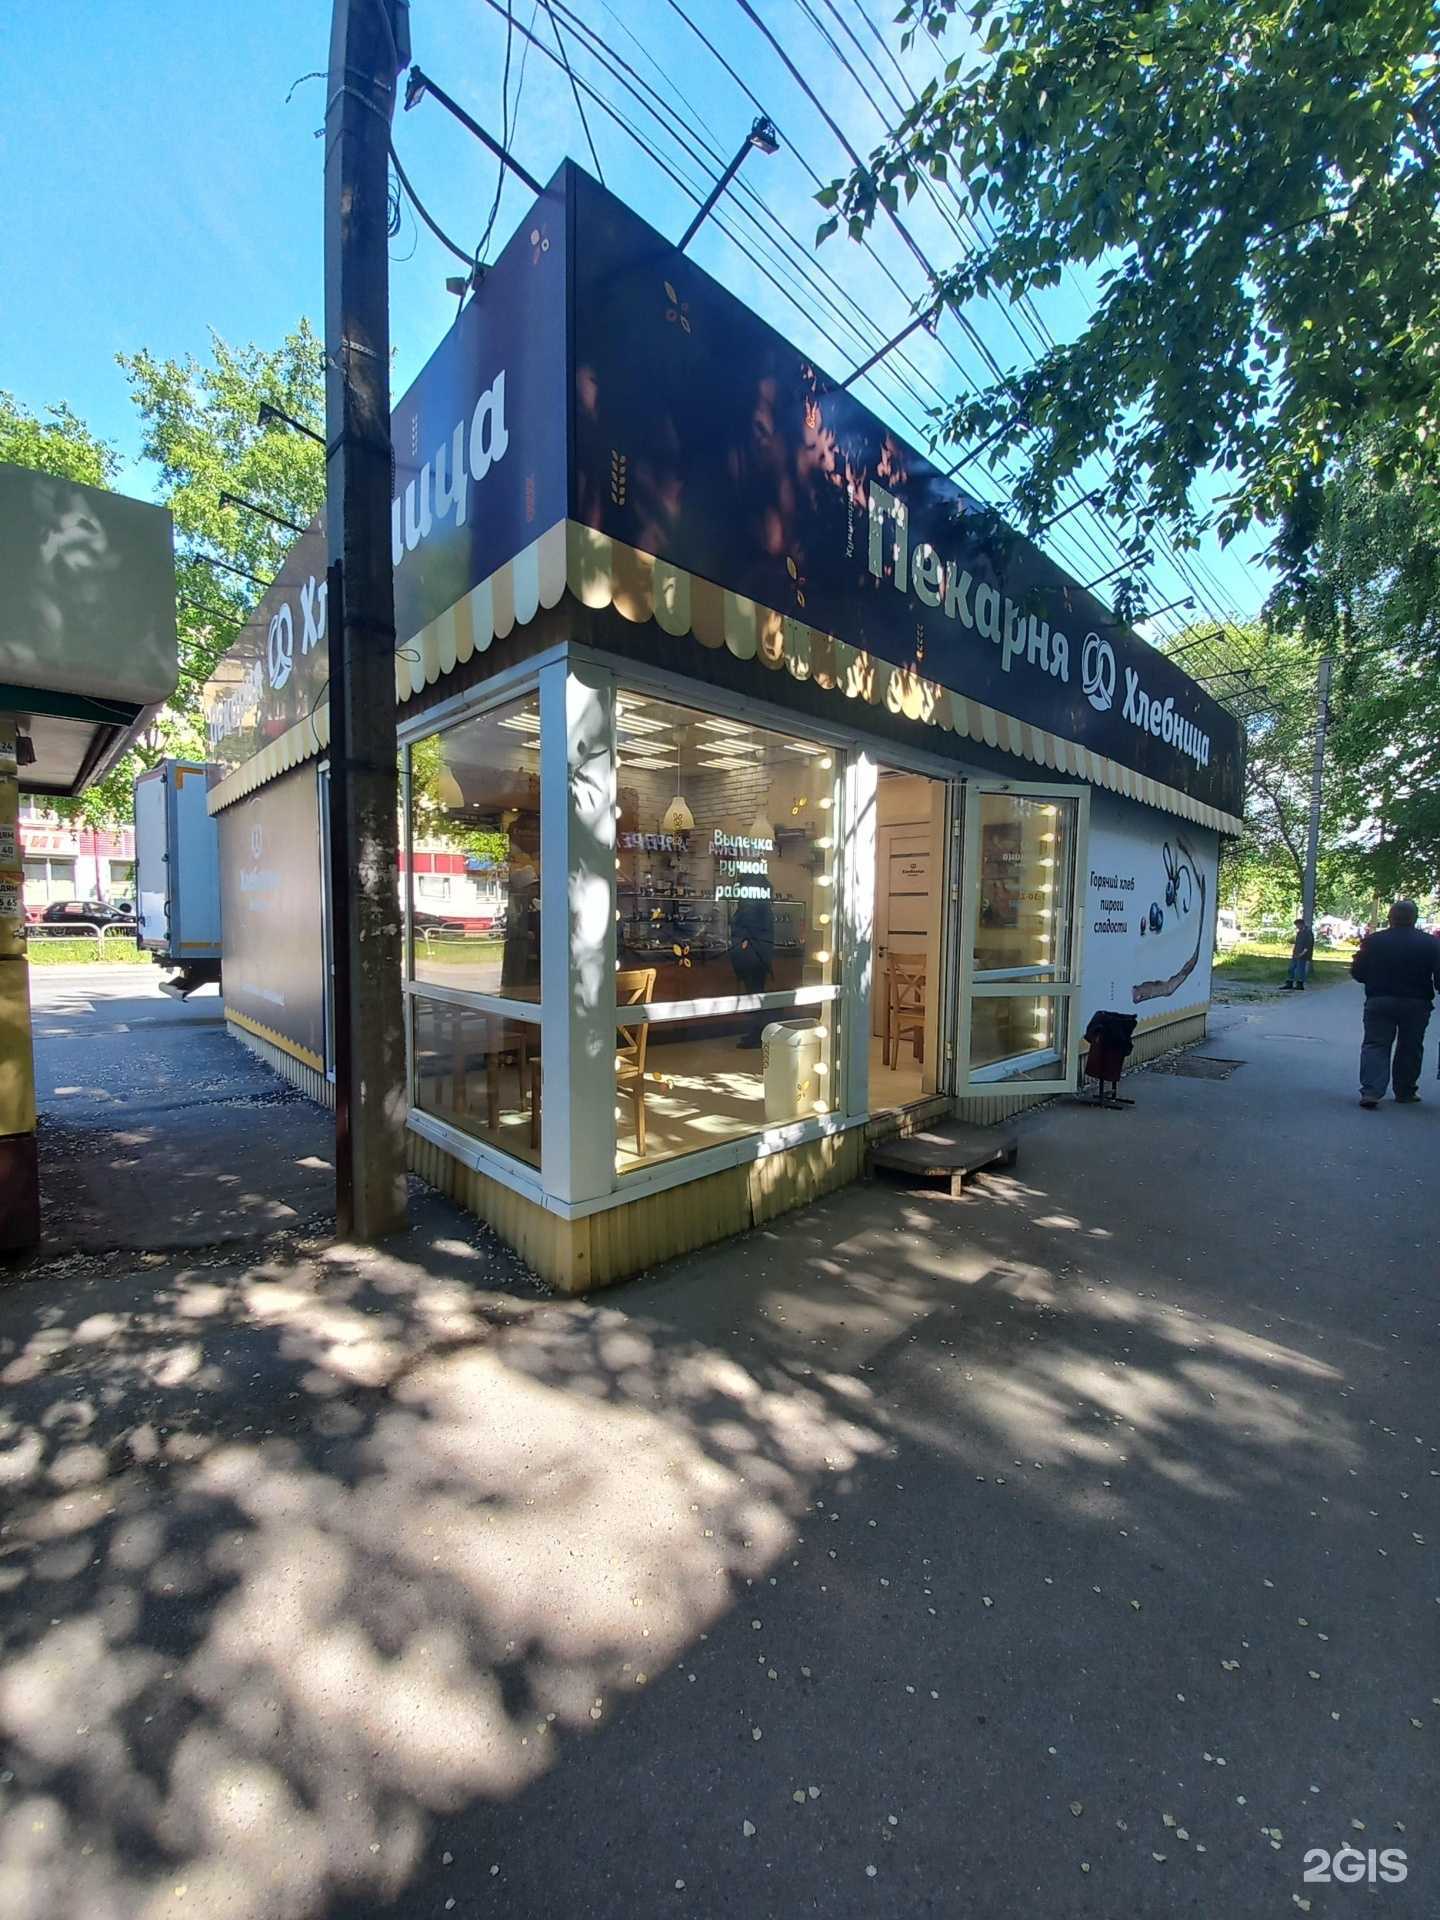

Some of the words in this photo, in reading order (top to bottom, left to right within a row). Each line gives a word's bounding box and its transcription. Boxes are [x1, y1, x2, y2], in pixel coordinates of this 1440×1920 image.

[868, 480, 1069, 682] Пекарня
[1122, 667, 1210, 770] Хлебница
[714, 829, 774, 851] Выпечка
[719, 859, 769, 877] ручной
[1090, 871, 1118, 890] Горячий
[1119, 877, 1135, 891] хлеб
[715, 883, 771, 901] работы
[1100, 899, 1124, 915] пироги
[1093, 918, 1128, 933] сладости
